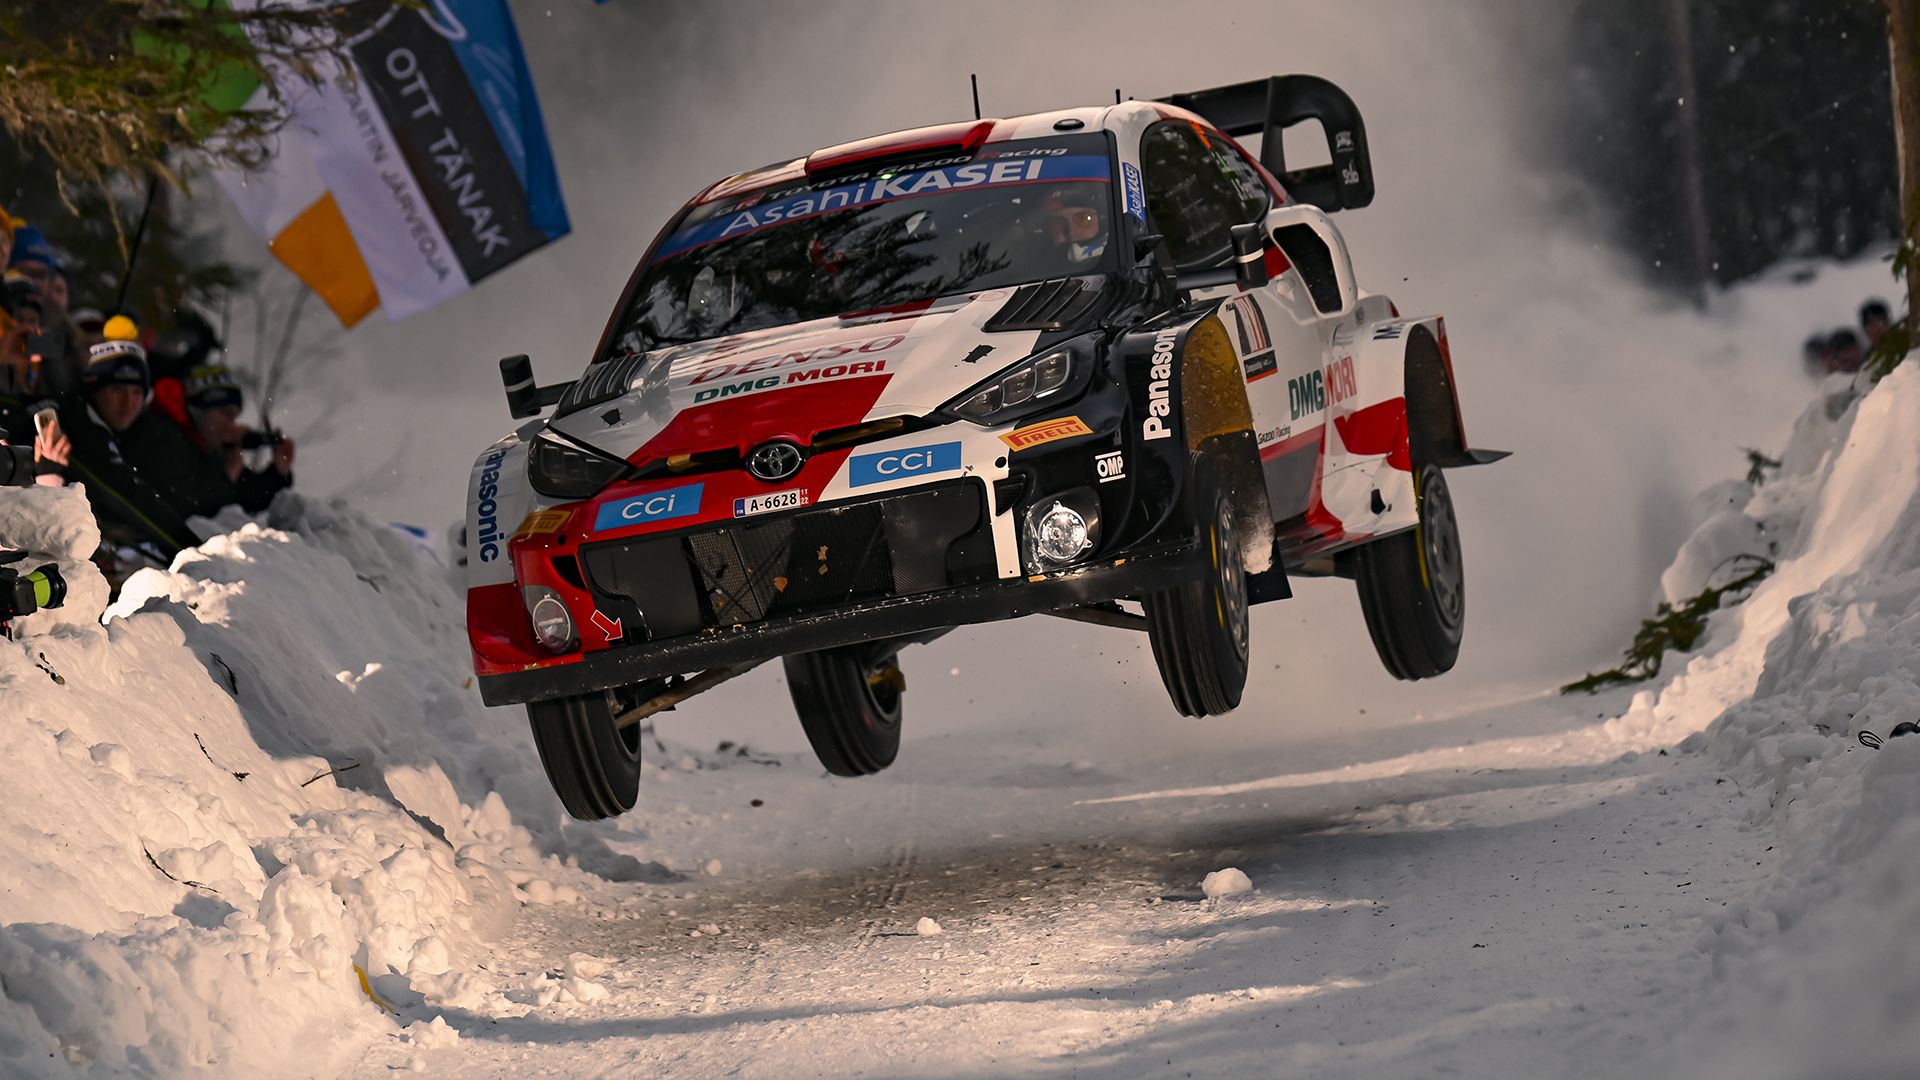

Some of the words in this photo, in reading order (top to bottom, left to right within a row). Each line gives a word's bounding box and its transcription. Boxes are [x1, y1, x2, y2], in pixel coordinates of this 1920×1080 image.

[339, 80, 388, 164] ARTIN
[386, 47, 442, 119] OTT
[428, 126, 511, 257] TÄNAK
[769, 172, 869, 200] TOYOTA
[877, 155, 972, 175] GAZOO
[978, 147, 1068, 160] Racing
[688, 335, 906, 386] DENSO
[1007, 420, 1083, 447] PIRELLI
[1096, 455, 1124, 477] OMP
[477, 450, 507, 563] anasonic
[750, 492, 797, 512] A-6628
[800, 497, 809, 505] 22
